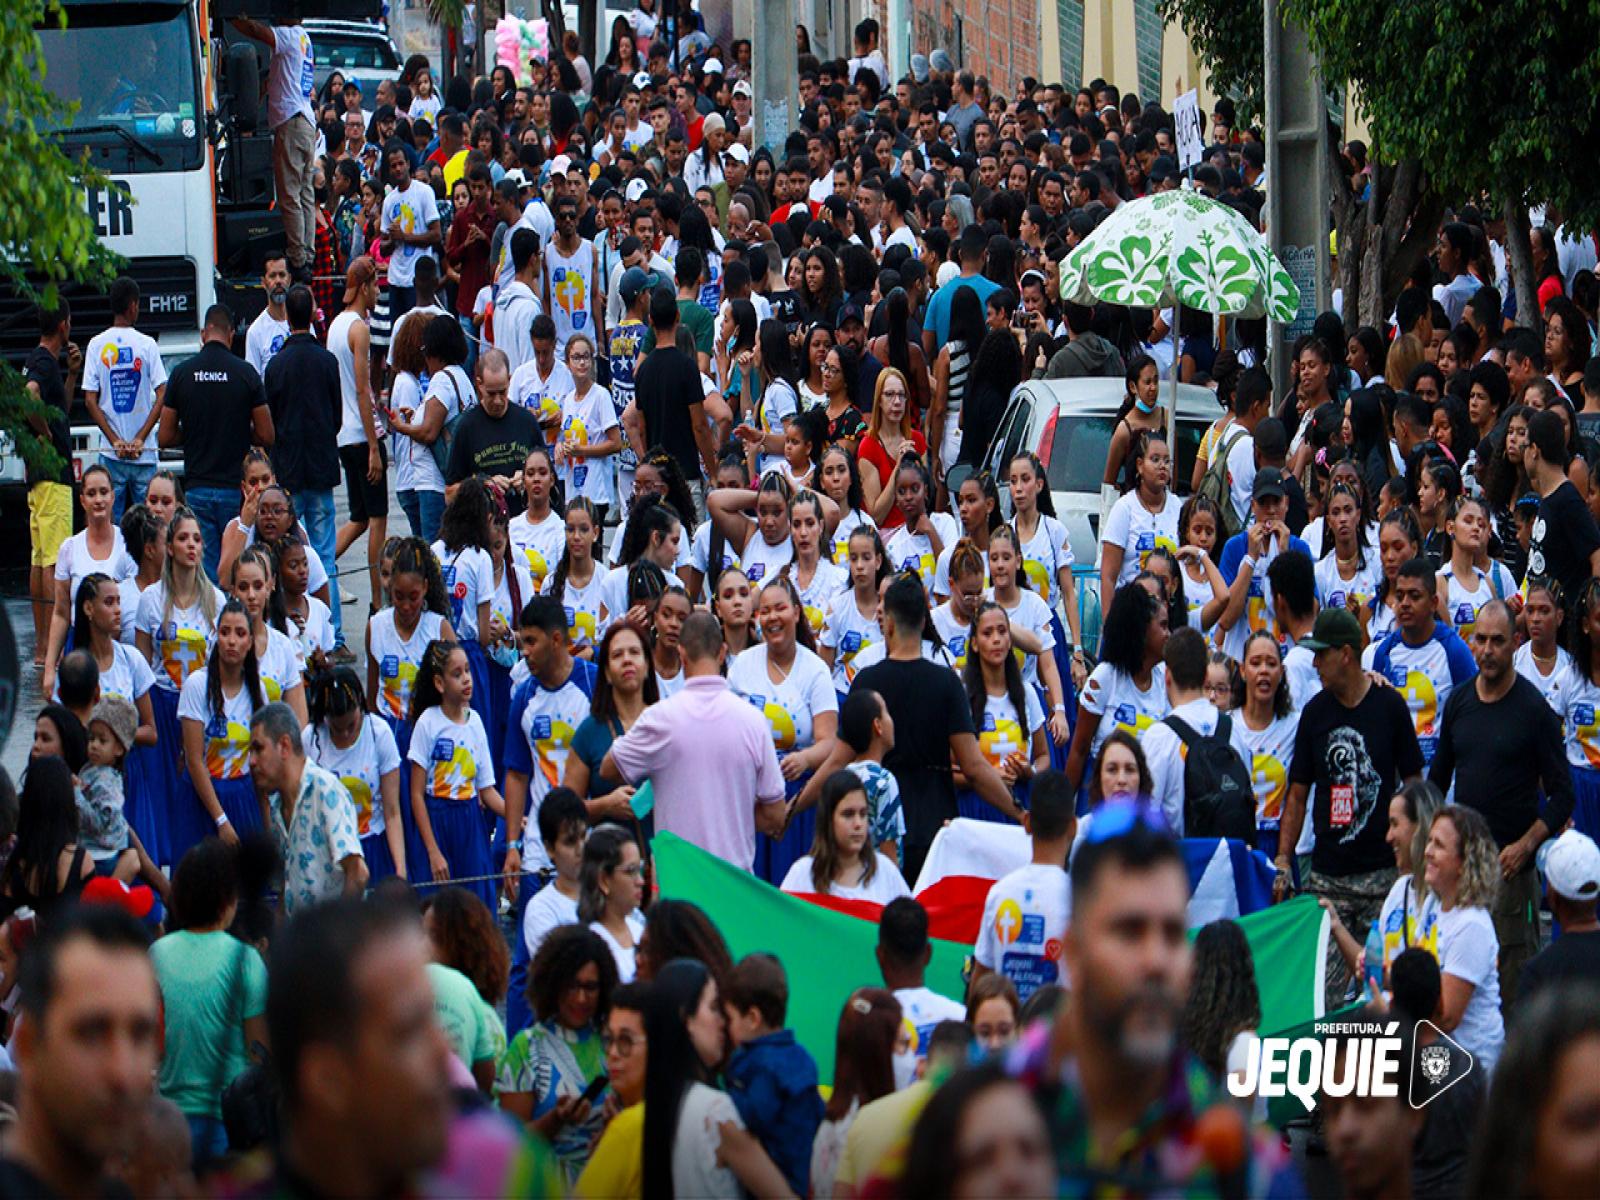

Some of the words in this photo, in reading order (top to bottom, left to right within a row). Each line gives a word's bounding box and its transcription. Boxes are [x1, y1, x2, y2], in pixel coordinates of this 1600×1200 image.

[87, 180, 134, 236] ER
[149, 295, 188, 313] FH12
[193, 370, 229, 382] TÉCNICA
